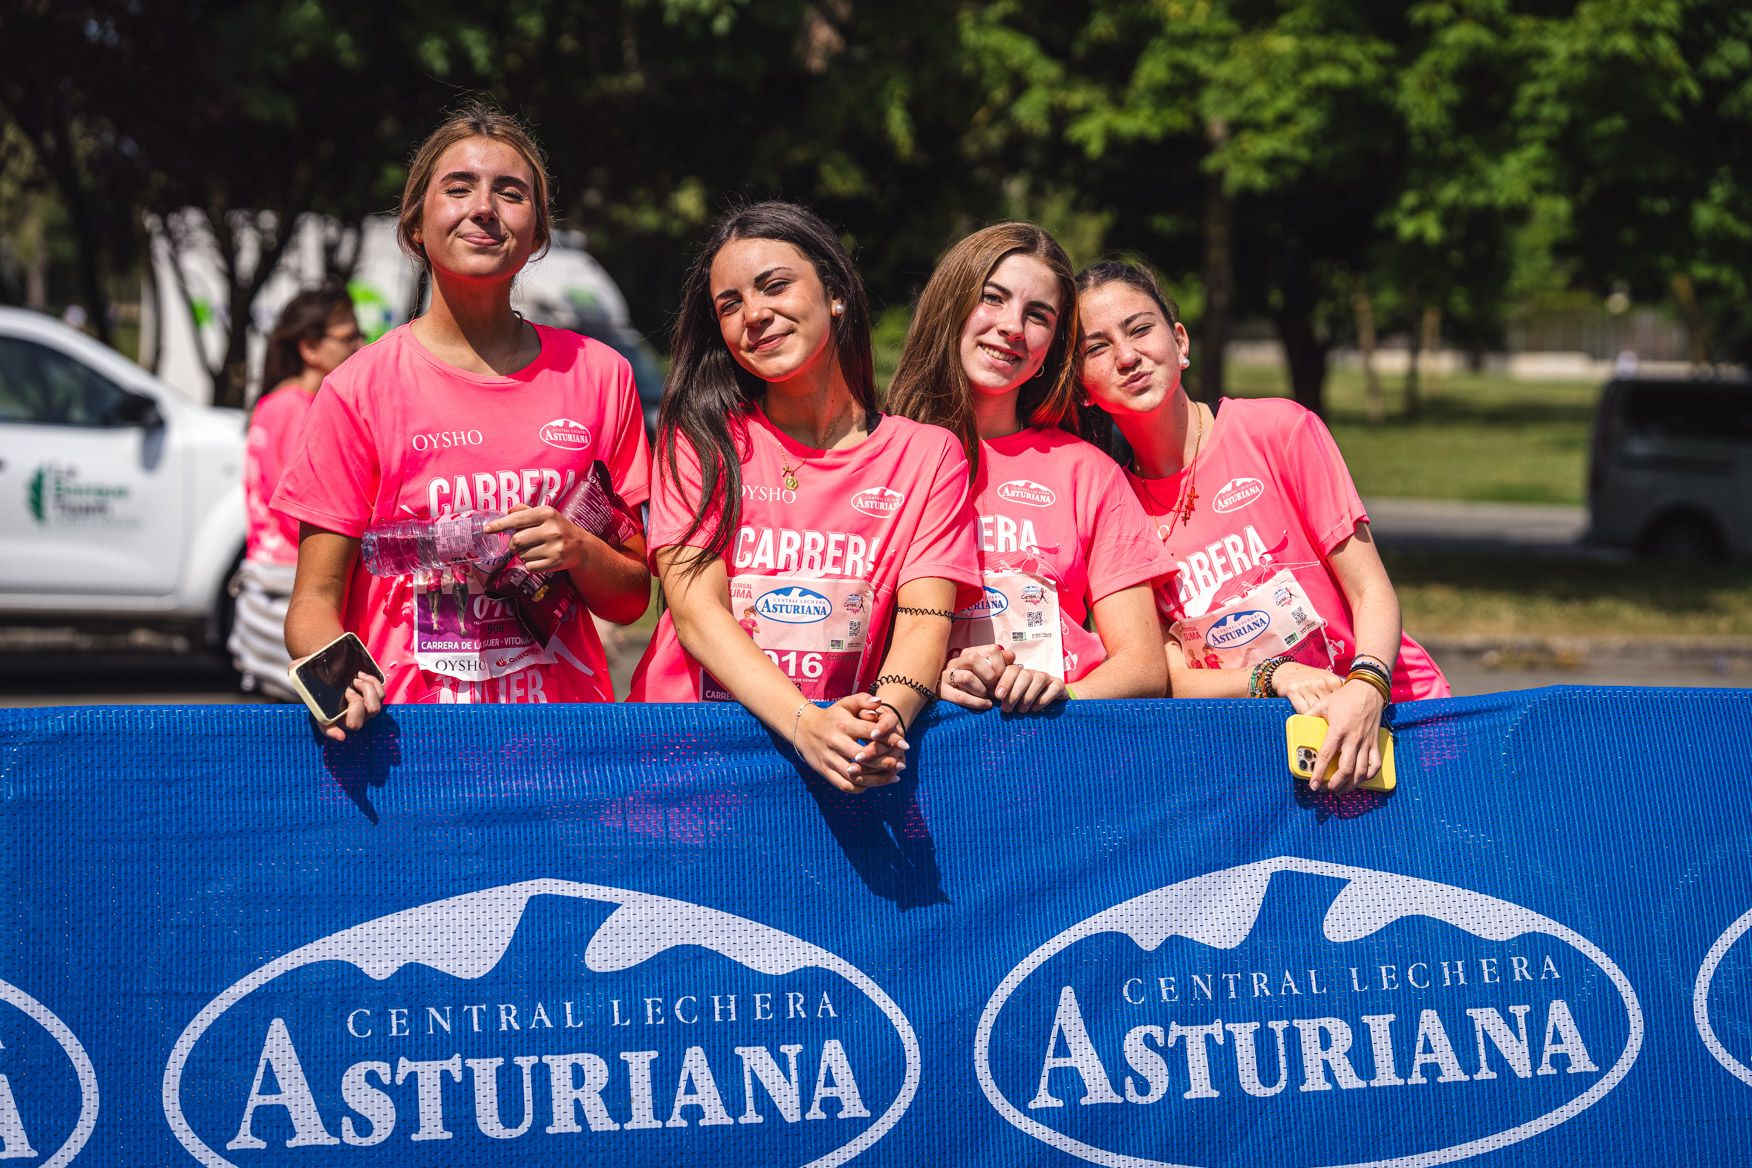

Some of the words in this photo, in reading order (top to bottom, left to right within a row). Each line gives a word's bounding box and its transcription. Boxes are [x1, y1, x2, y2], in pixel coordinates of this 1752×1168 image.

[412, 429, 483, 451] OYSHO
[545, 429, 589, 443] ASTURIANA
[1002, 486, 1051, 503] ASTURIANA
[1217, 485, 1261, 510] ASTURIANA
[761, 599, 828, 616] ASTURIANA
[1211, 618, 1267, 646] ASTURIANA
[421, 641, 460, 650] CARRERA
[461, 641, 473, 650] DE
[435, 659, 486, 672] OYSHO
[1122, 969, 1327, 1005] CENTRAL
[1351, 954, 1562, 993] LECHERA
[346, 1001, 584, 1038] CENTRAL
[611, 990, 839, 1027] LECHERA
[1027, 985, 1600, 1109] ASTURIANA
[226, 1017, 872, 1150] ASTURIANA
